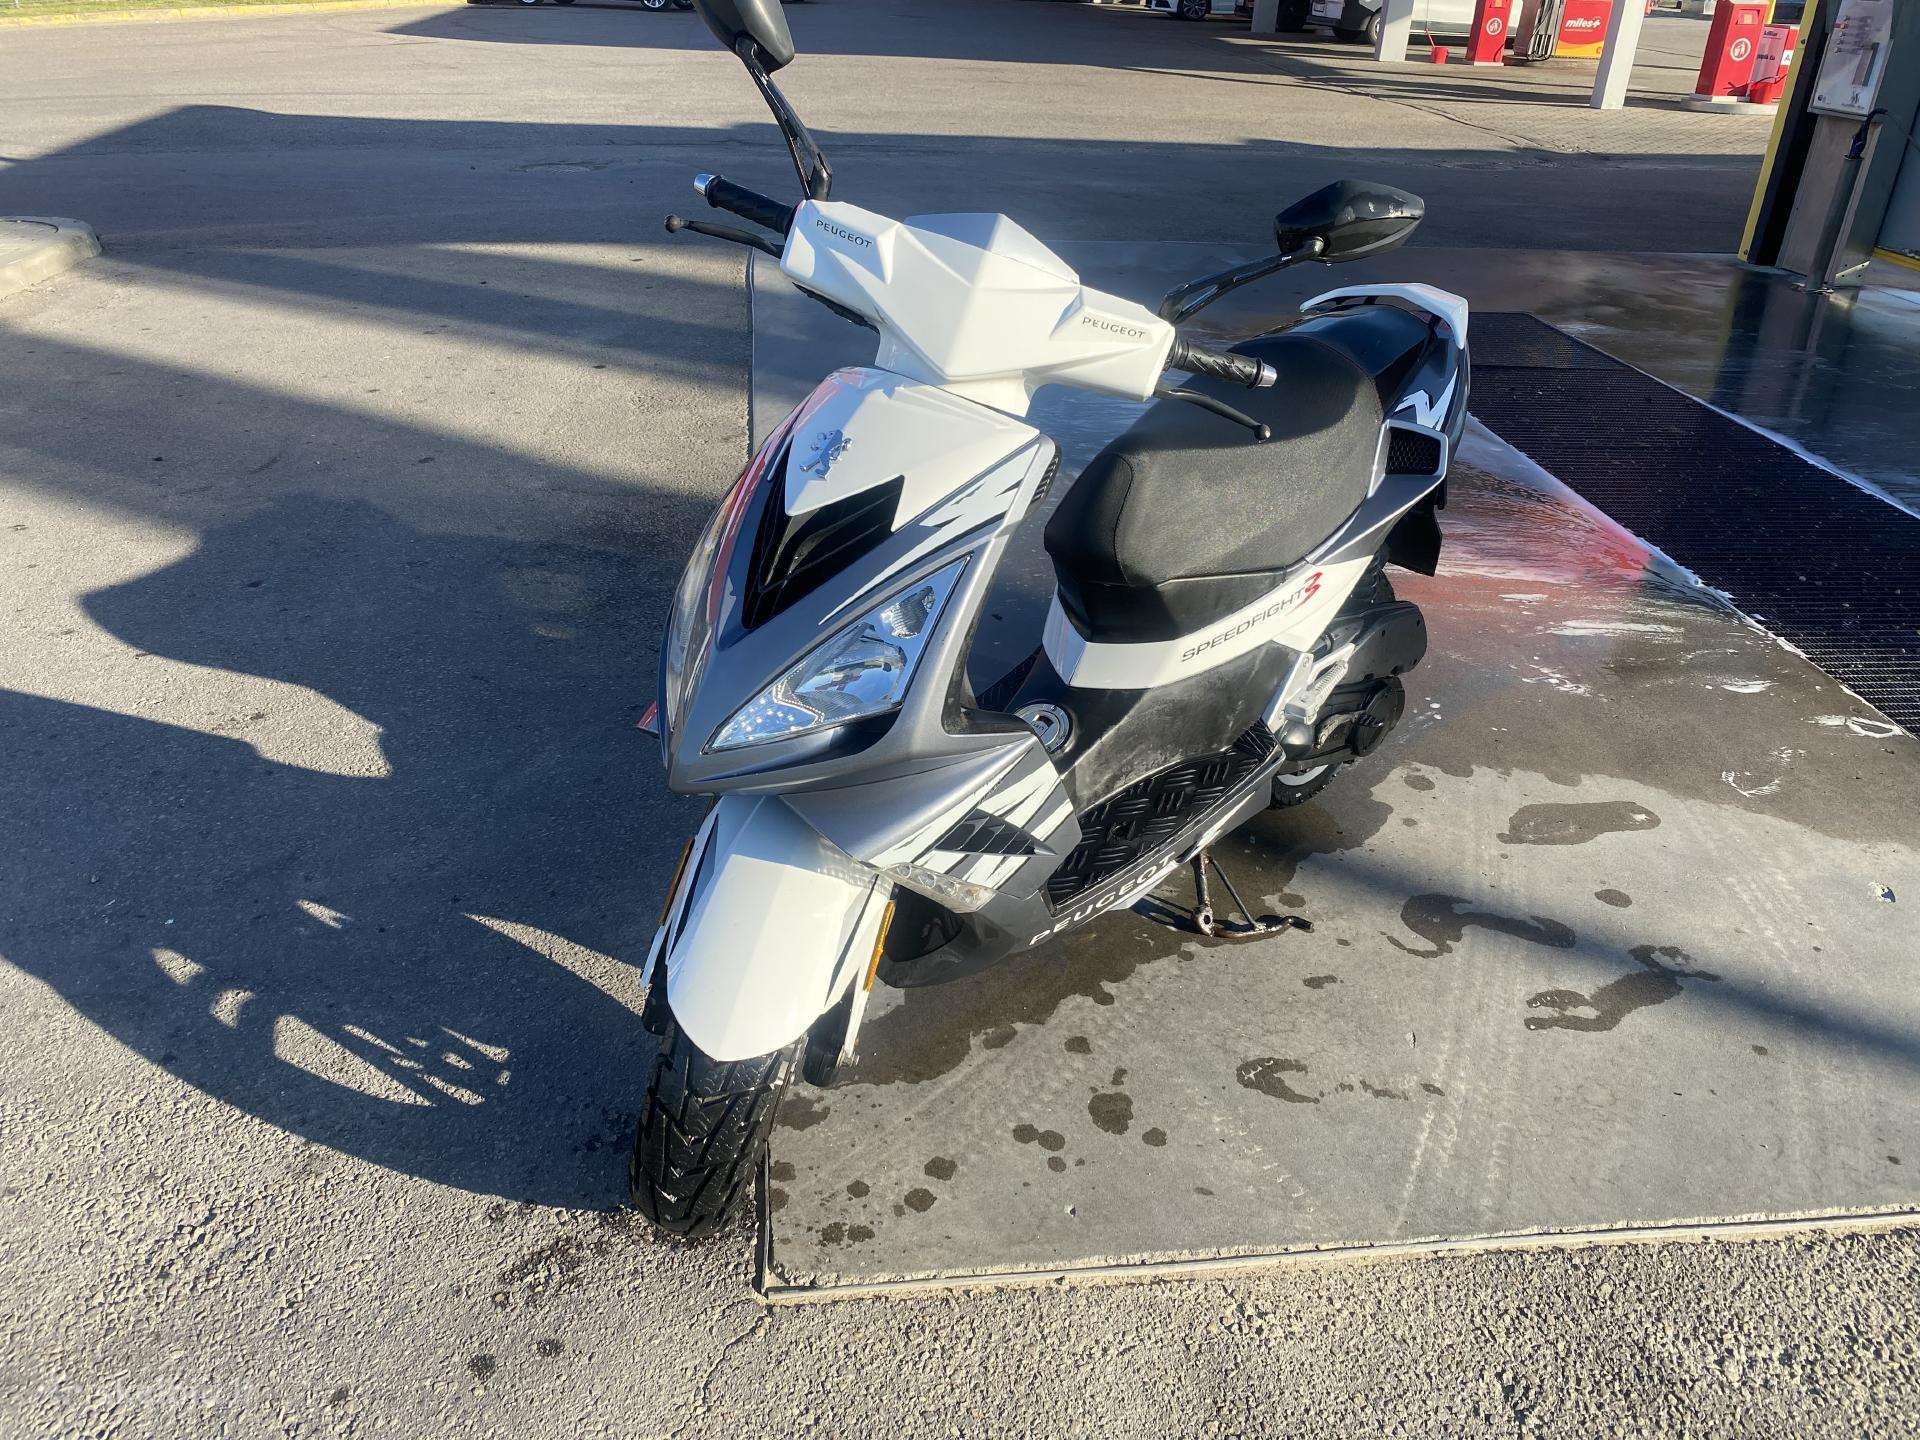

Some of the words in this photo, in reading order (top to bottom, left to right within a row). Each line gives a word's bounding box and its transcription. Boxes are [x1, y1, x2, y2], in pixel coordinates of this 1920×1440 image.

[816, 219, 872, 248] PEUGEOT
[1082, 316, 1147, 338] PEUGEOT
[1028, 851, 1176, 946] PEUGEOT
